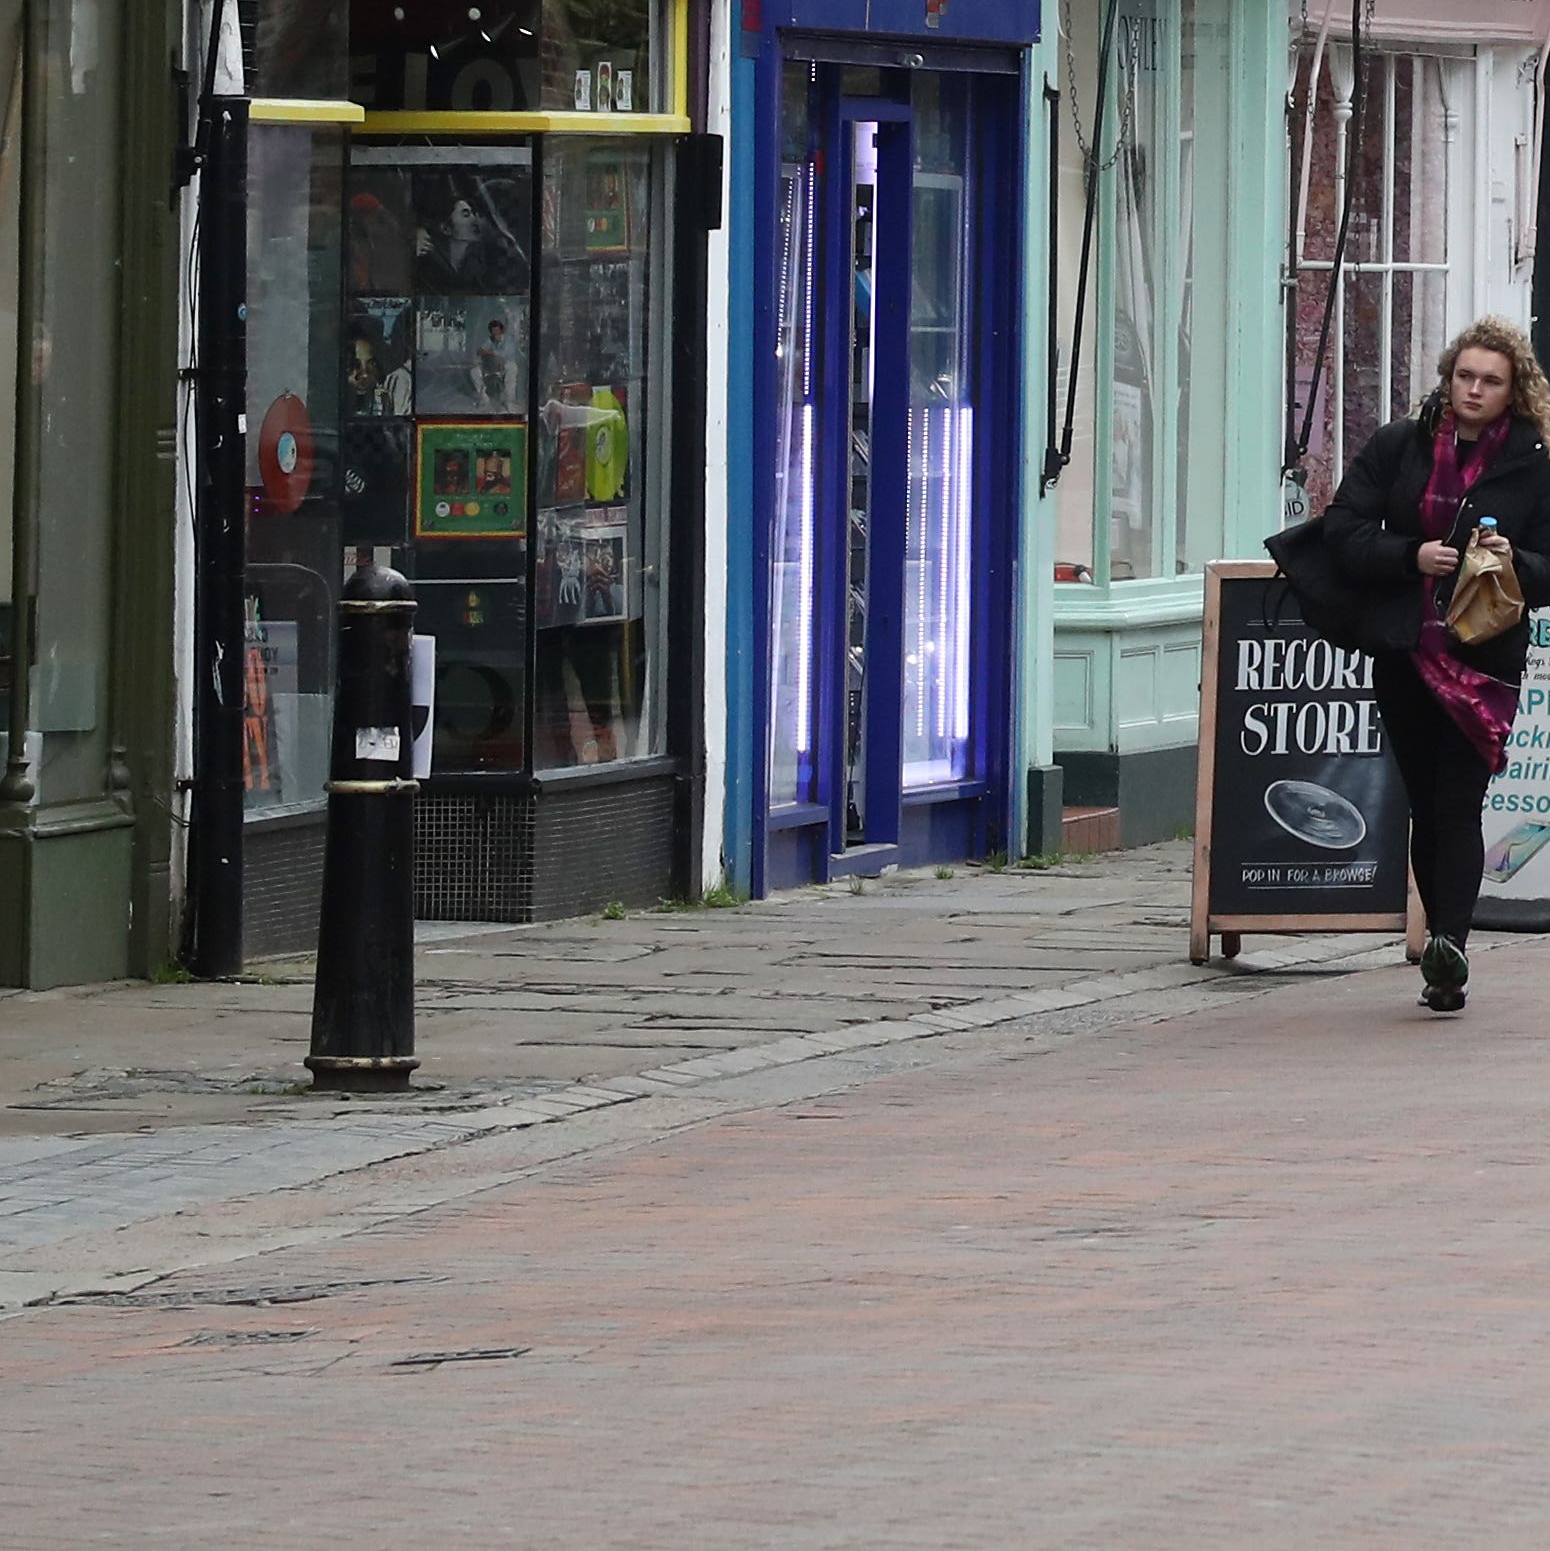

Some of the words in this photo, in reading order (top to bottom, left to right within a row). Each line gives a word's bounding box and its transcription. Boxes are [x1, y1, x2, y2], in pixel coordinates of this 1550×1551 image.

[1240, 700, 1381, 756] STORE
[1242, 869, 1265, 882] POP
[1267, 869, 1281, 882] IN
[1287, 869, 1309, 882] FOR
[1312, 869, 1321, 882] A
